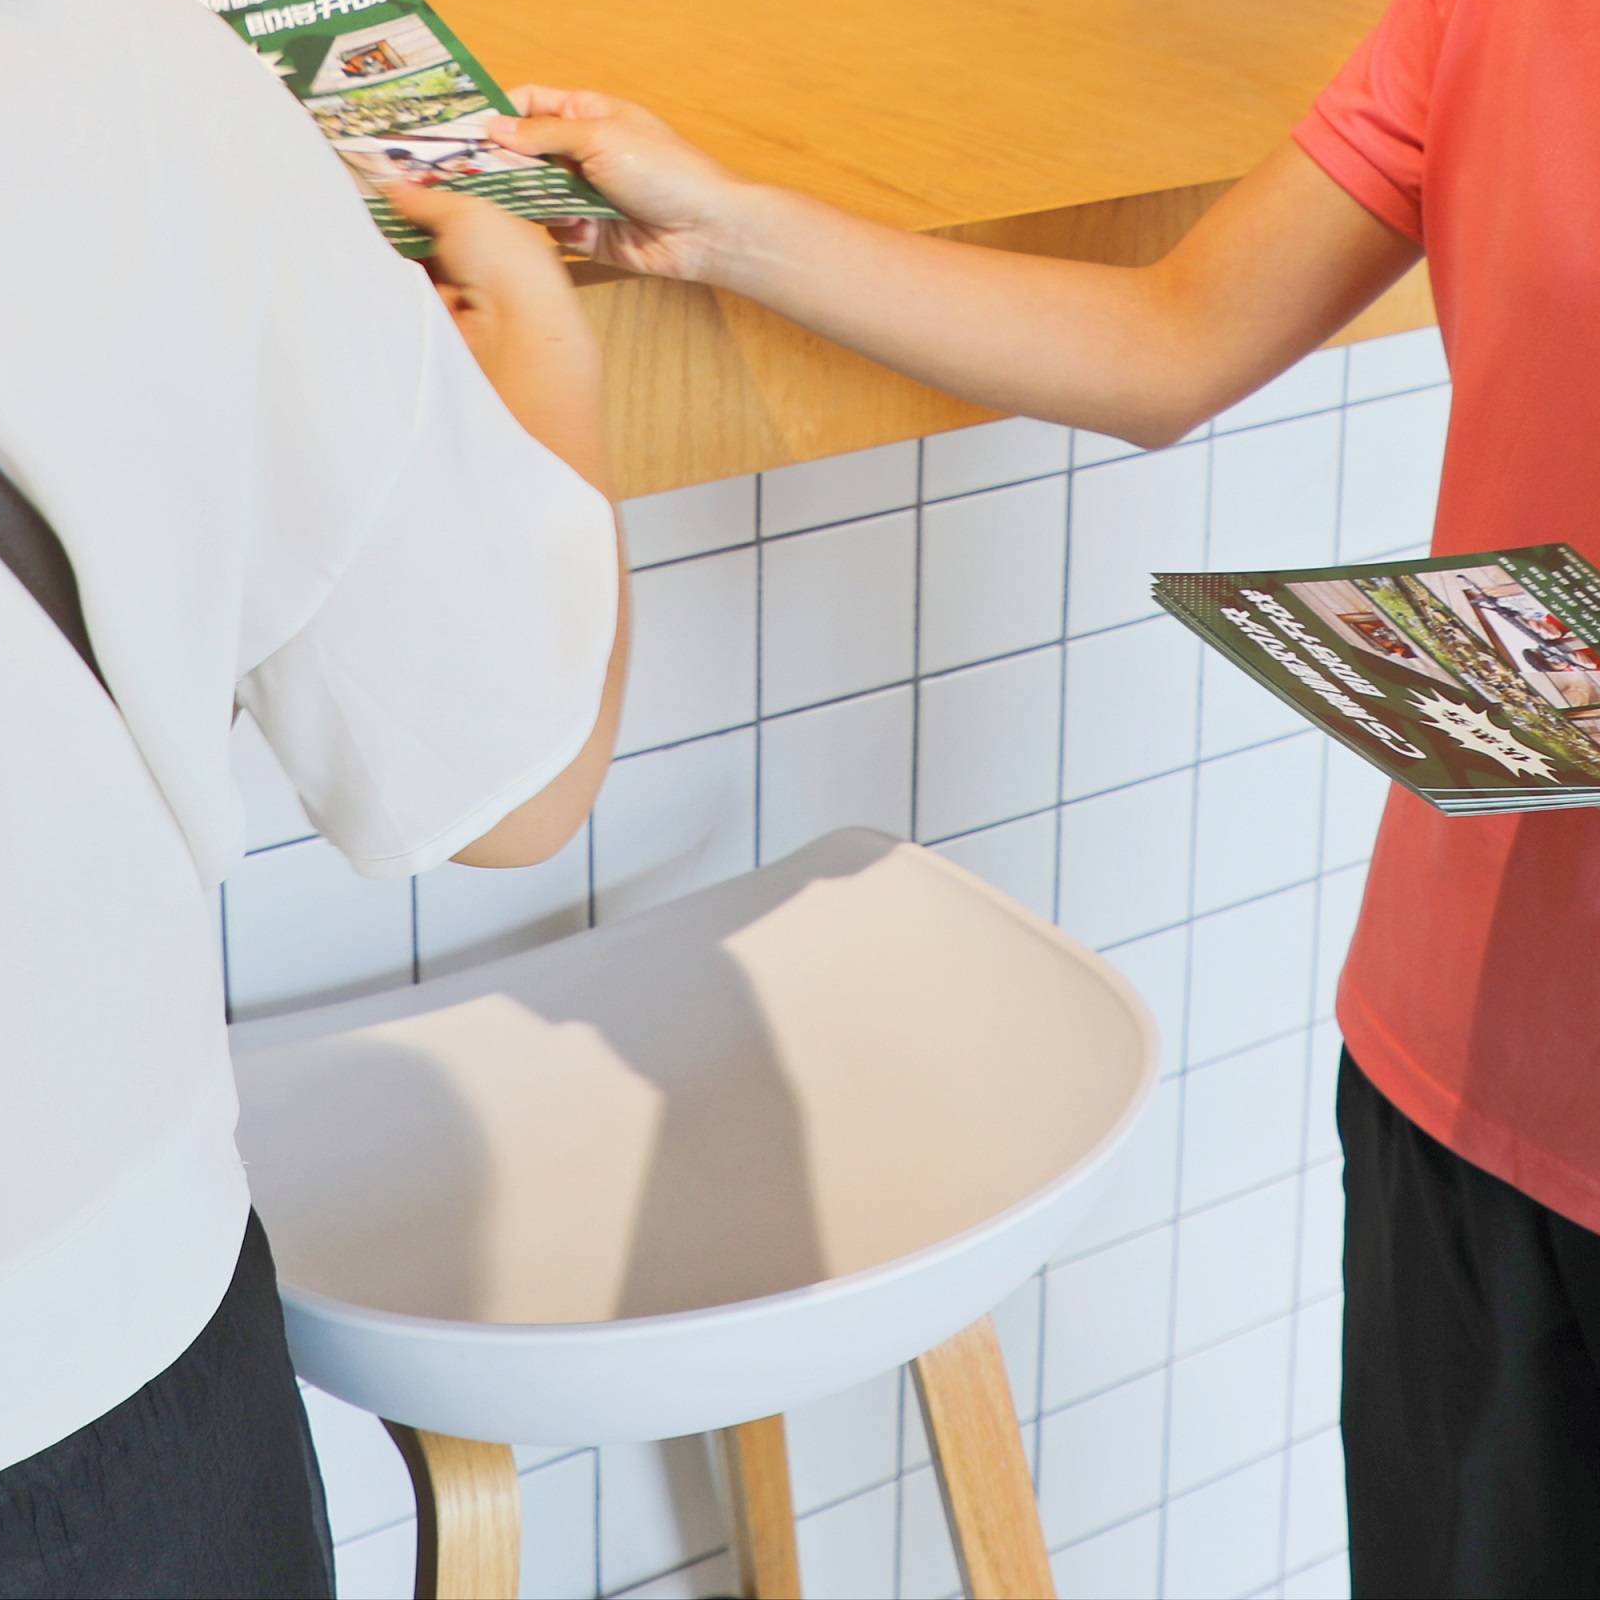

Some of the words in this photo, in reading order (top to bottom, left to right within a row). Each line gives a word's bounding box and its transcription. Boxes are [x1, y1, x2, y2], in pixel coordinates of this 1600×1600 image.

[1221, 608, 1426, 758] CS巅峰对决
[1239, 590, 1385, 696] 即将开战
[1443, 709, 1530, 762] 优惠券
